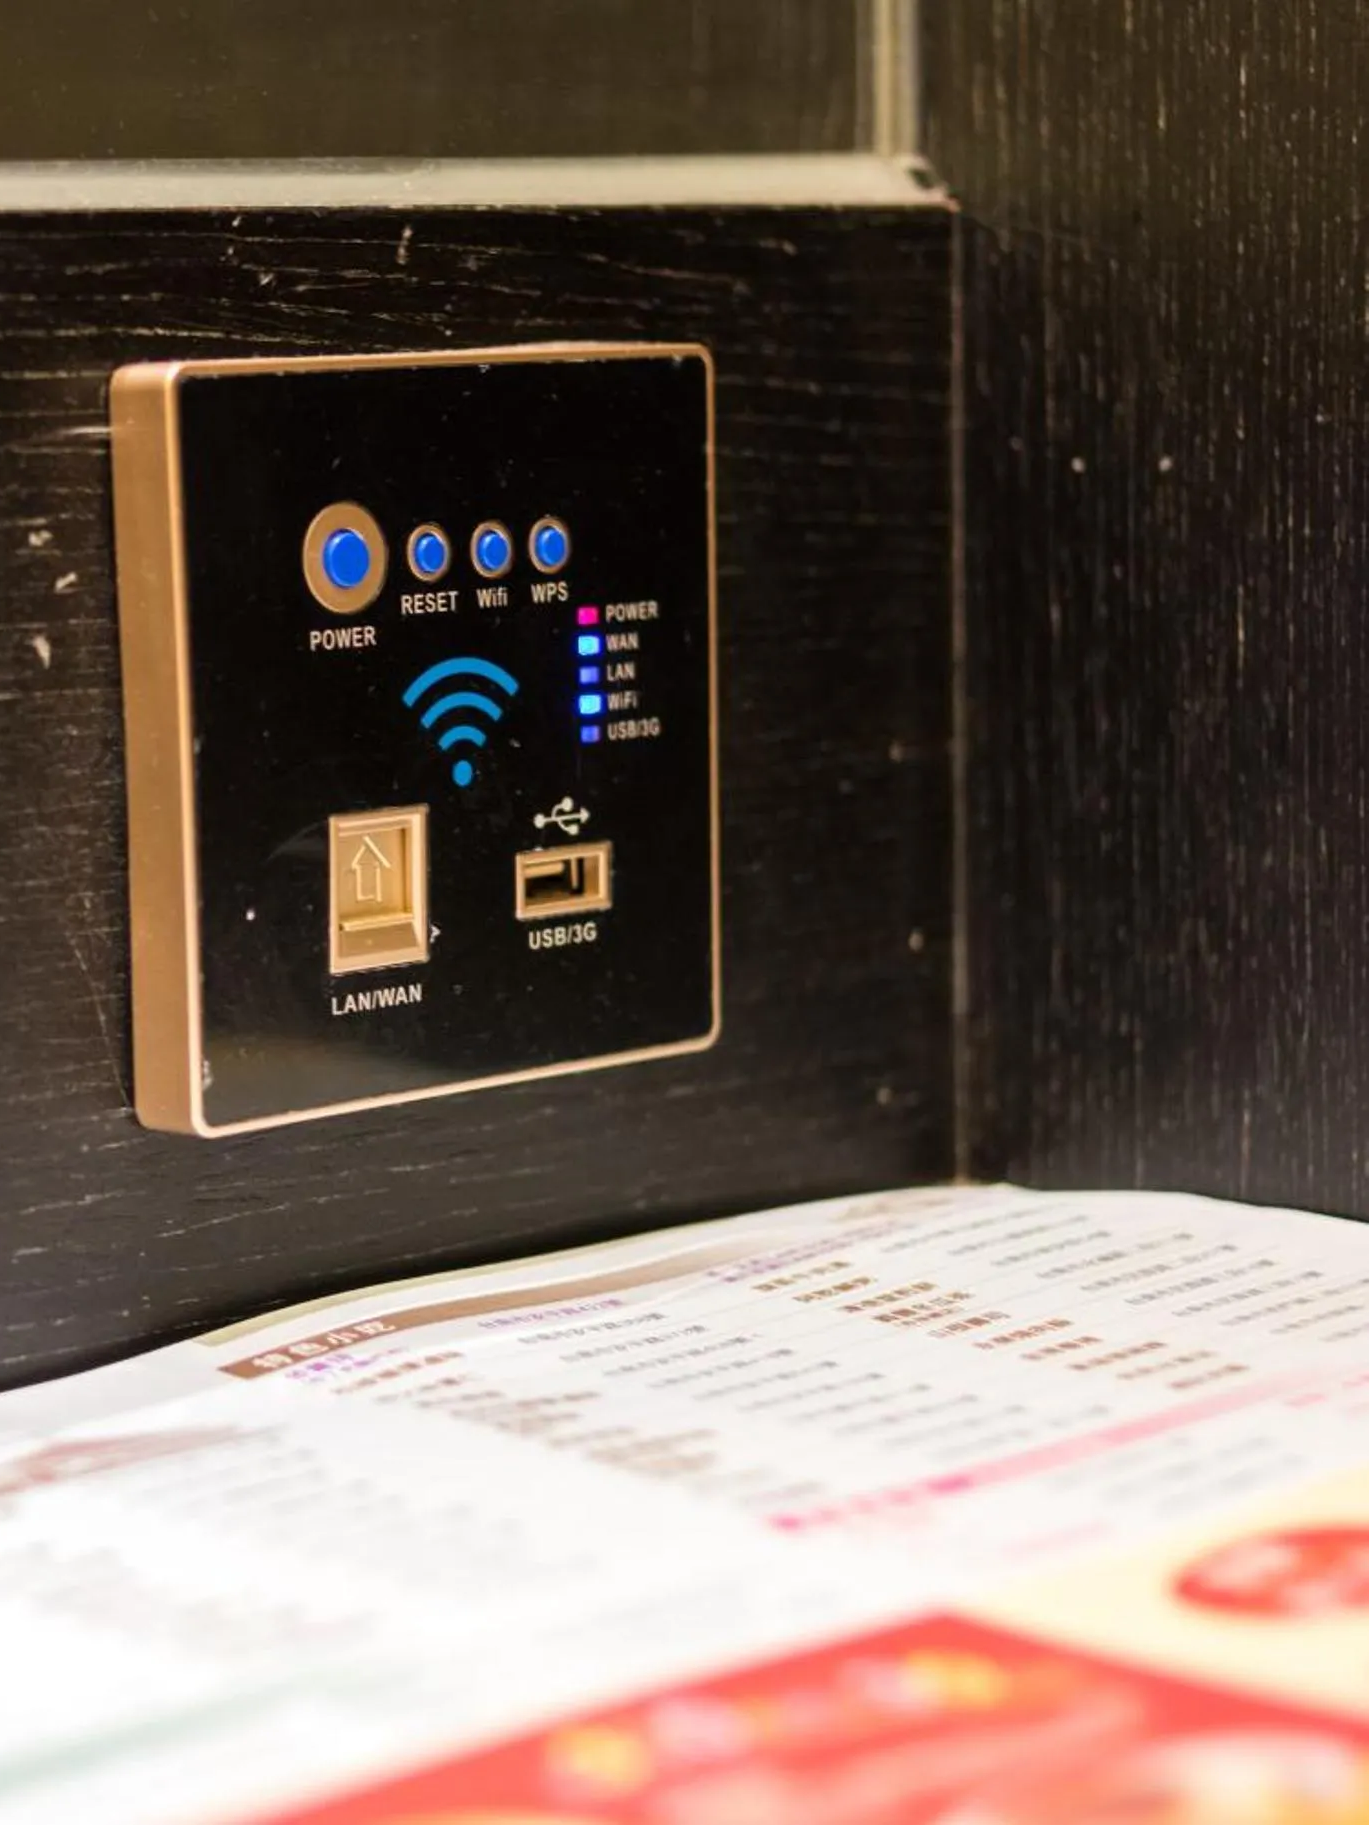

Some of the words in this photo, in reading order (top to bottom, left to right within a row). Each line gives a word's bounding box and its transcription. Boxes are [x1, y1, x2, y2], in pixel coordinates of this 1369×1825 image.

[401, 591, 458, 615] RESET
[476, 587, 508, 608] Wifi
[531, 581, 569, 604] WPS
[606, 600, 659, 623] POWER
[310, 626, 377, 652] POWER
[606, 632, 639, 651] WAN
[607, 661, 635, 681] LAN
[607, 717, 661, 740] USB/3G
[529, 922, 597, 950] USB/3G
[332, 983, 423, 1016] LAN/WAN
